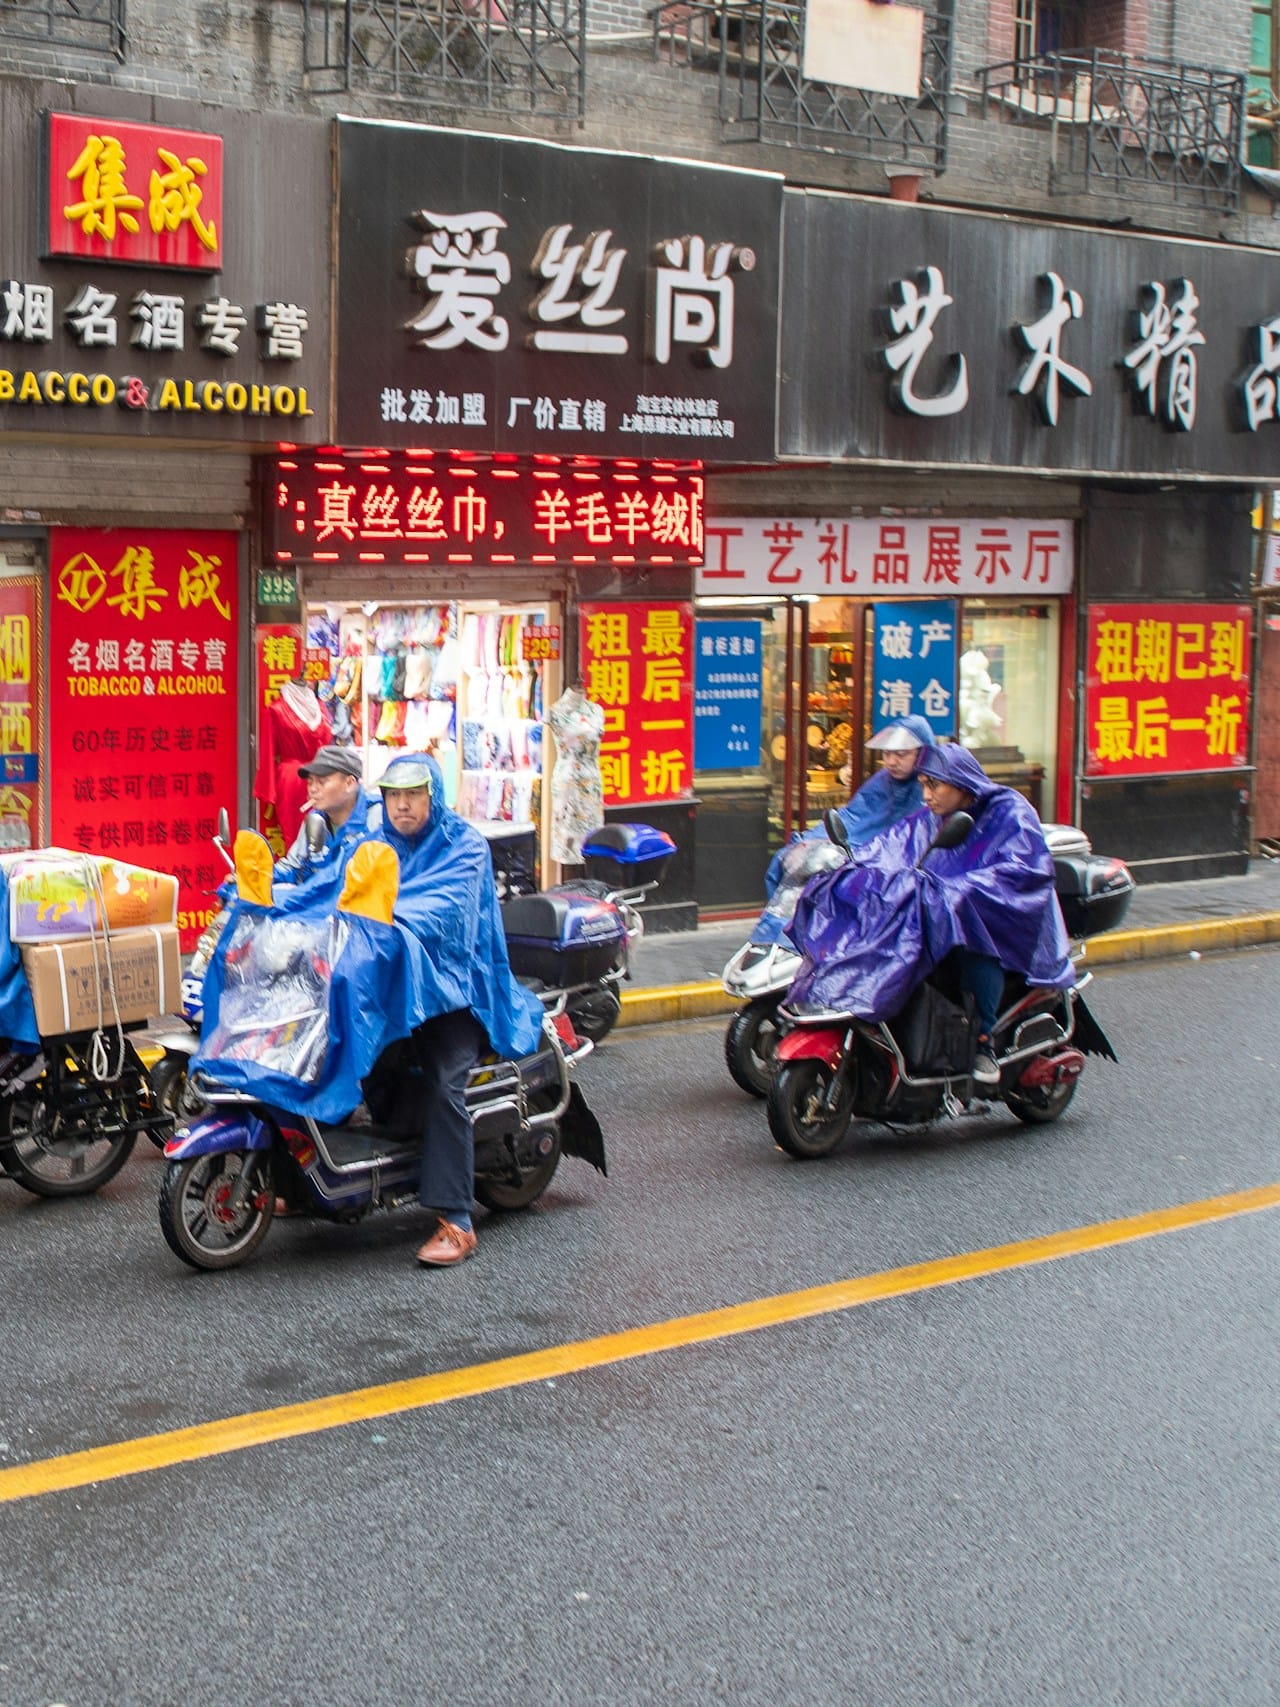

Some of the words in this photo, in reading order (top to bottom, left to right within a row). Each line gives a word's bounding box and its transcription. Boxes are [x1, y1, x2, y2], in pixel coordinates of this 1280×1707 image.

[64, 134, 218, 253] 集成
[410, 208, 735, 369] 爱丝尚
[125, 376, 148, 409] &
[159, 378, 314, 416] ALCOHOL
[380, 387, 487, 426] 批发加盟
[506, 396, 607, 433] 厂价直销
[700, 521, 1060, 585] 工艺礼品展示厅
[106, 545, 232, 621] 集成
[263, 574, 296, 594] 395
[67, 637, 227, 673] 名烟名酒专营
[880, 620, 952, 659] 破产
[1095, 618, 1244, 684] 租期已到
[586, 611, 631, 800] 租期已到
[641, 610, 686, 797] 最后一折
[878, 678, 951, 718] 清仓
[72, 725, 218, 752] 60年历史老店
[1094, 693, 1242, 762] 最后一折
[73, 771, 215, 801] 诚实可信可靠
[73, 817, 216, 850] 专供网络卷烟
[156, 863, 217, 891] 饮料
[176, 909, 215, 930] 5116
